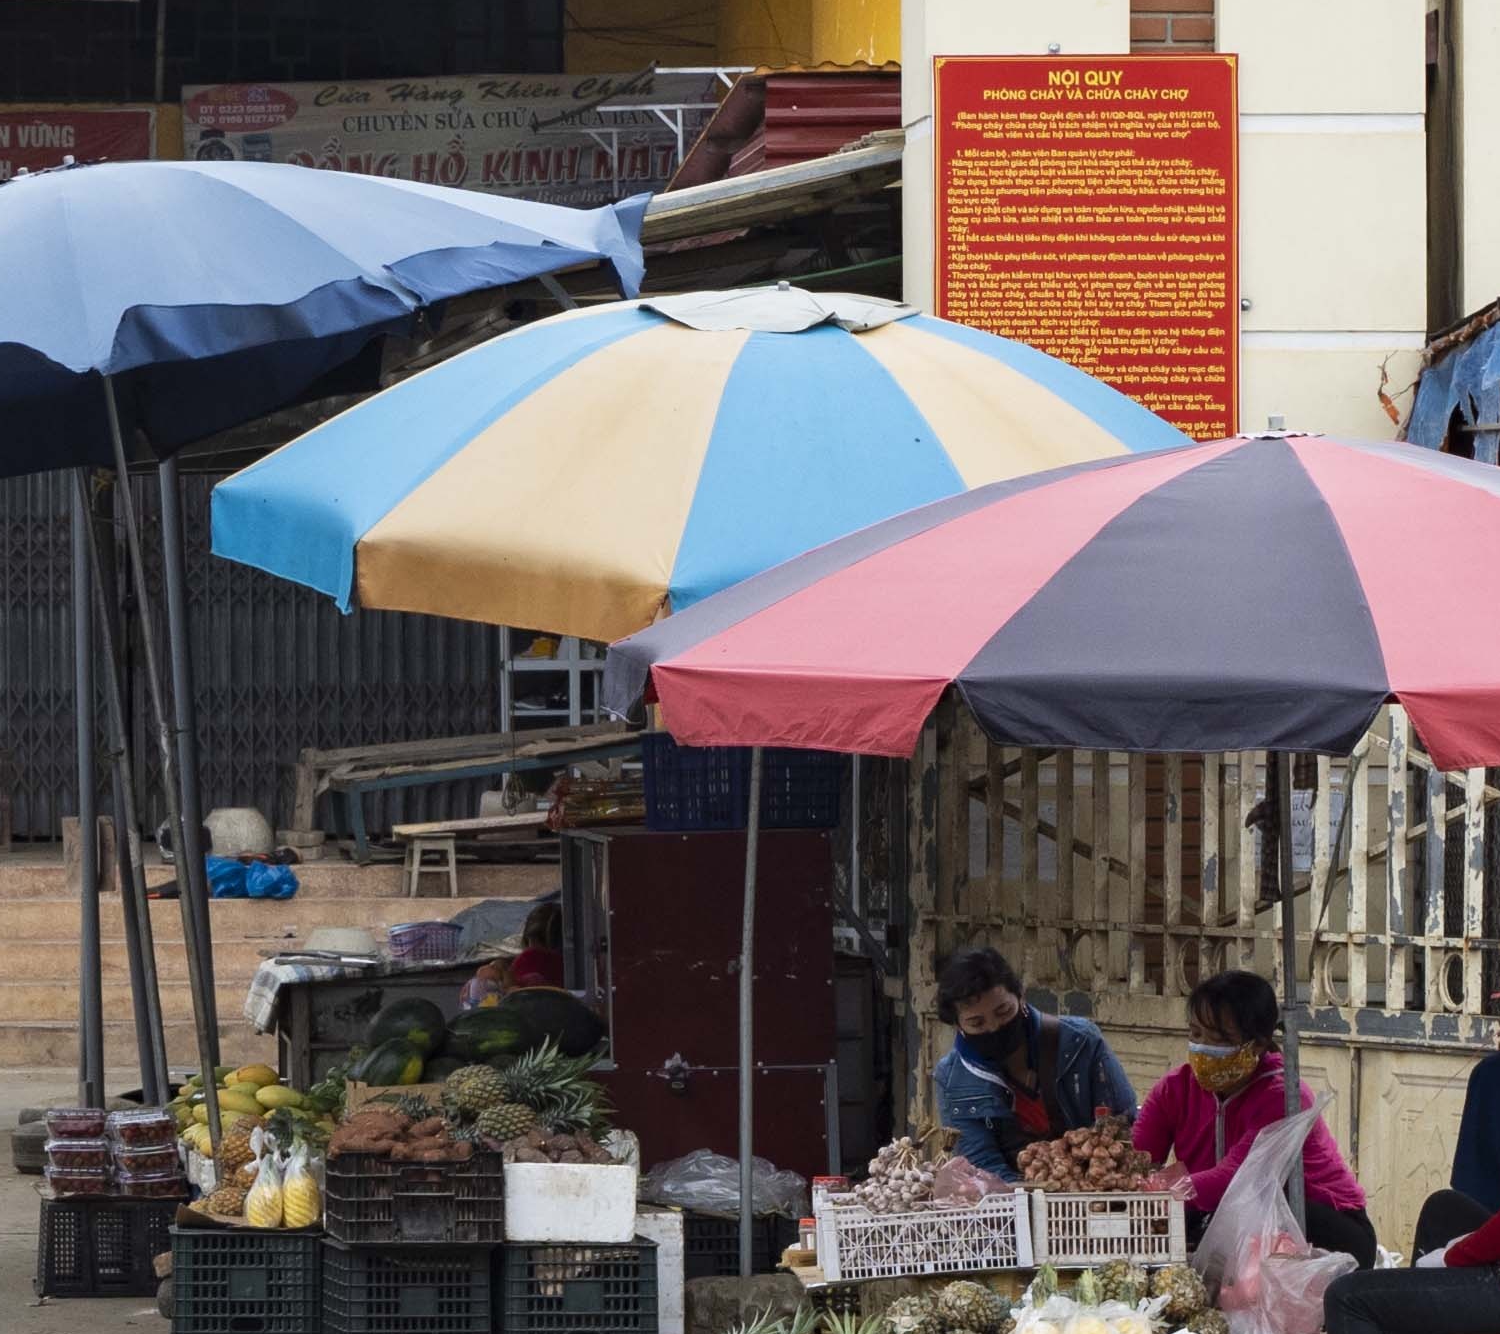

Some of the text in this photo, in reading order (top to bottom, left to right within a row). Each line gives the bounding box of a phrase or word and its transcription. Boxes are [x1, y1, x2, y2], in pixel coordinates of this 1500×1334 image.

[1047, 69, 1124, 89] NỘI QUY
[983, 87, 1189, 101] PHÒNG CHÁY VÀ CHỮA CHÁY CHỢ
[342, 110, 428, 133] CHUYÊN
[434, 105, 475, 130] SỬA
[17, 119, 76, 148] VỮNG
[411, 135, 469, 186] HỒ
[480, 141, 581, 186] KÍNH
